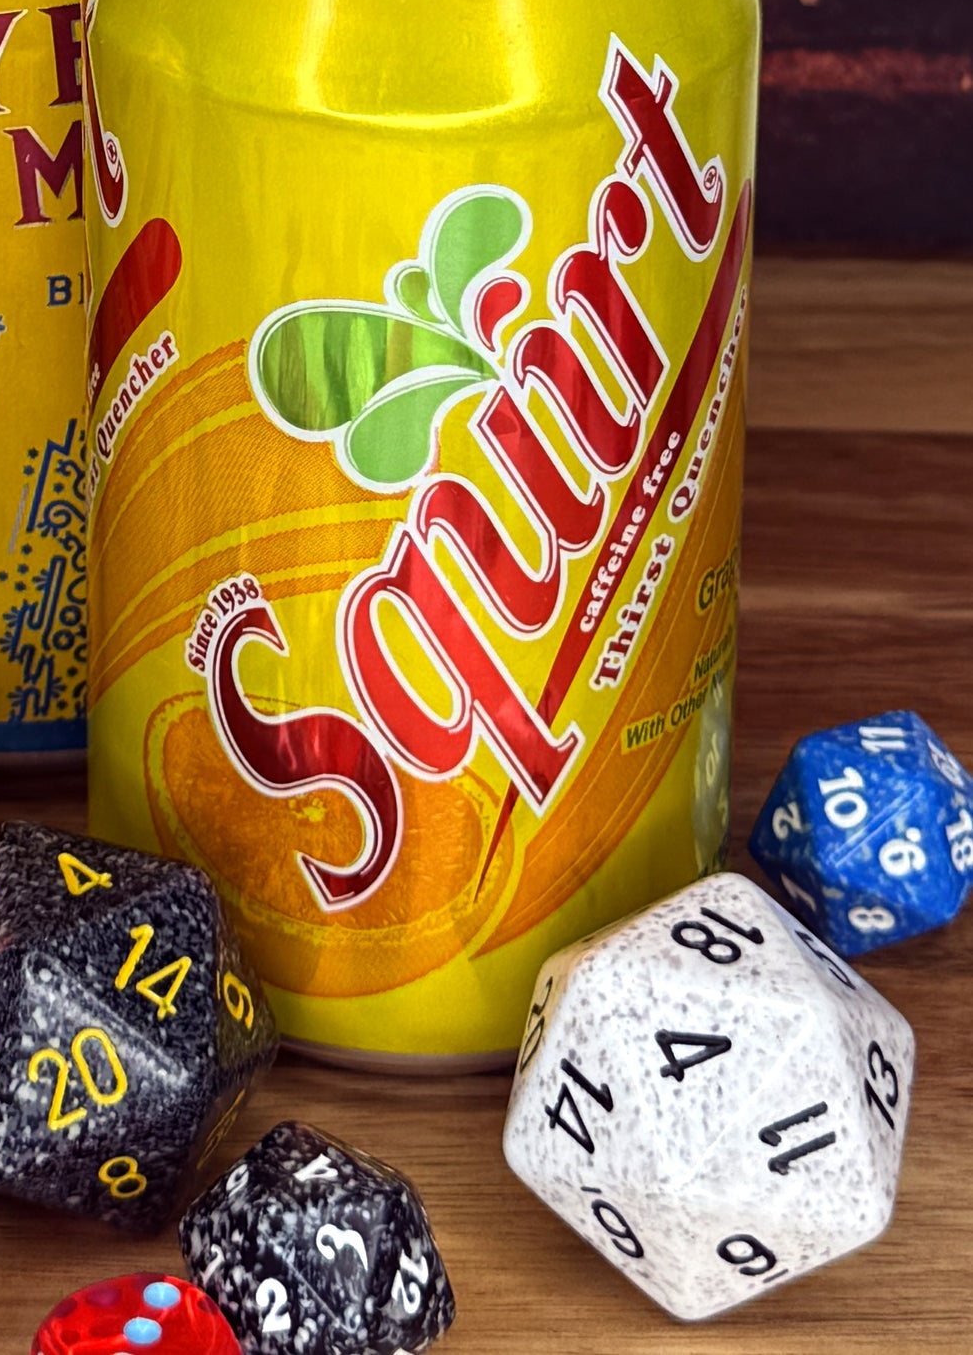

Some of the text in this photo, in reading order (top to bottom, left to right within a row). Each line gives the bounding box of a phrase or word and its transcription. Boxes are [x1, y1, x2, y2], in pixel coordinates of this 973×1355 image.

[96, 334, 176, 461] Quencher
[207, 33, 723, 912] Squirt
[594, 285, 748, 687] Thirst Quencher
[580, 431, 681, 633] caffeine free
[187, 577, 260, 672] Since 1938
[626, 693, 708, 749] With Other
[858, 725, 907, 754] 11
[772, 801, 803, 841] 2
[818, 766, 868, 829] 10
[57, 852, 113, 896] 4
[670, 906, 765, 965] 18
[847, 905, 895, 934] 8
[115, 922, 192, 1020] 14
[27, 1027, 128, 1132] 20
[654, 1028, 733, 1082] 4
[862, 1039, 900, 1130] 13
[544, 1057, 615, 1155] 14
[758, 1101, 837, 1176] 11
[98, 1155, 147, 1199] 8
[255, 1277, 292, 1333] 2
